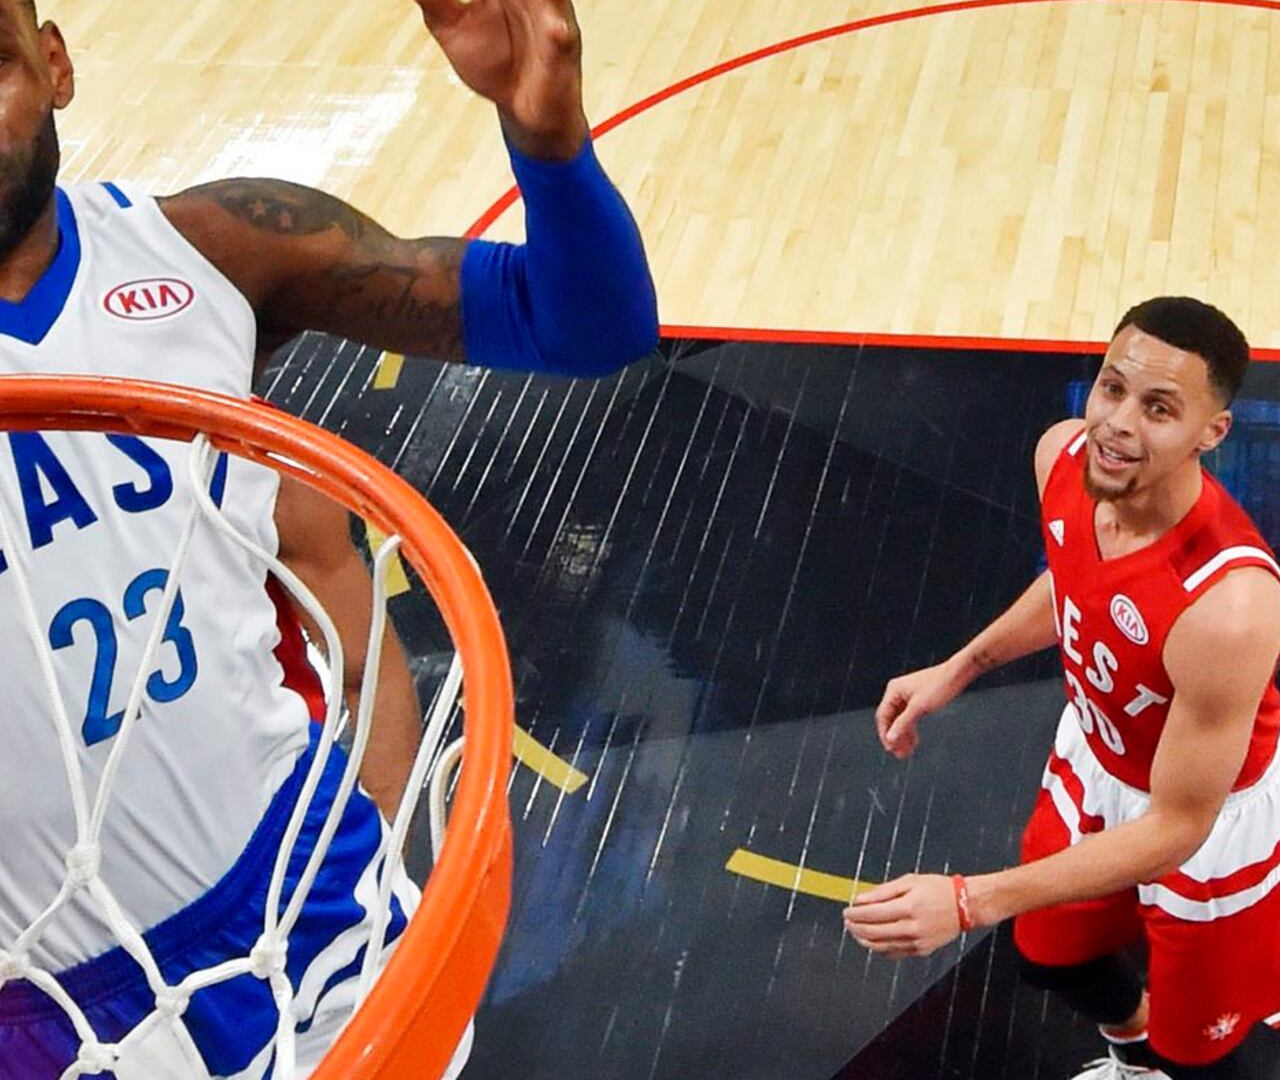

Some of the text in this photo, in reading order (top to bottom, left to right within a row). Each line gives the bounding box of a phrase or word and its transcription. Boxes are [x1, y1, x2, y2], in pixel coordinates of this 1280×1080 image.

[117, 283, 181, 315] KIA
[48, 567, 198, 748] 23
[1055, 594, 1168, 717] EST
[1065, 669, 1125, 756] 30
